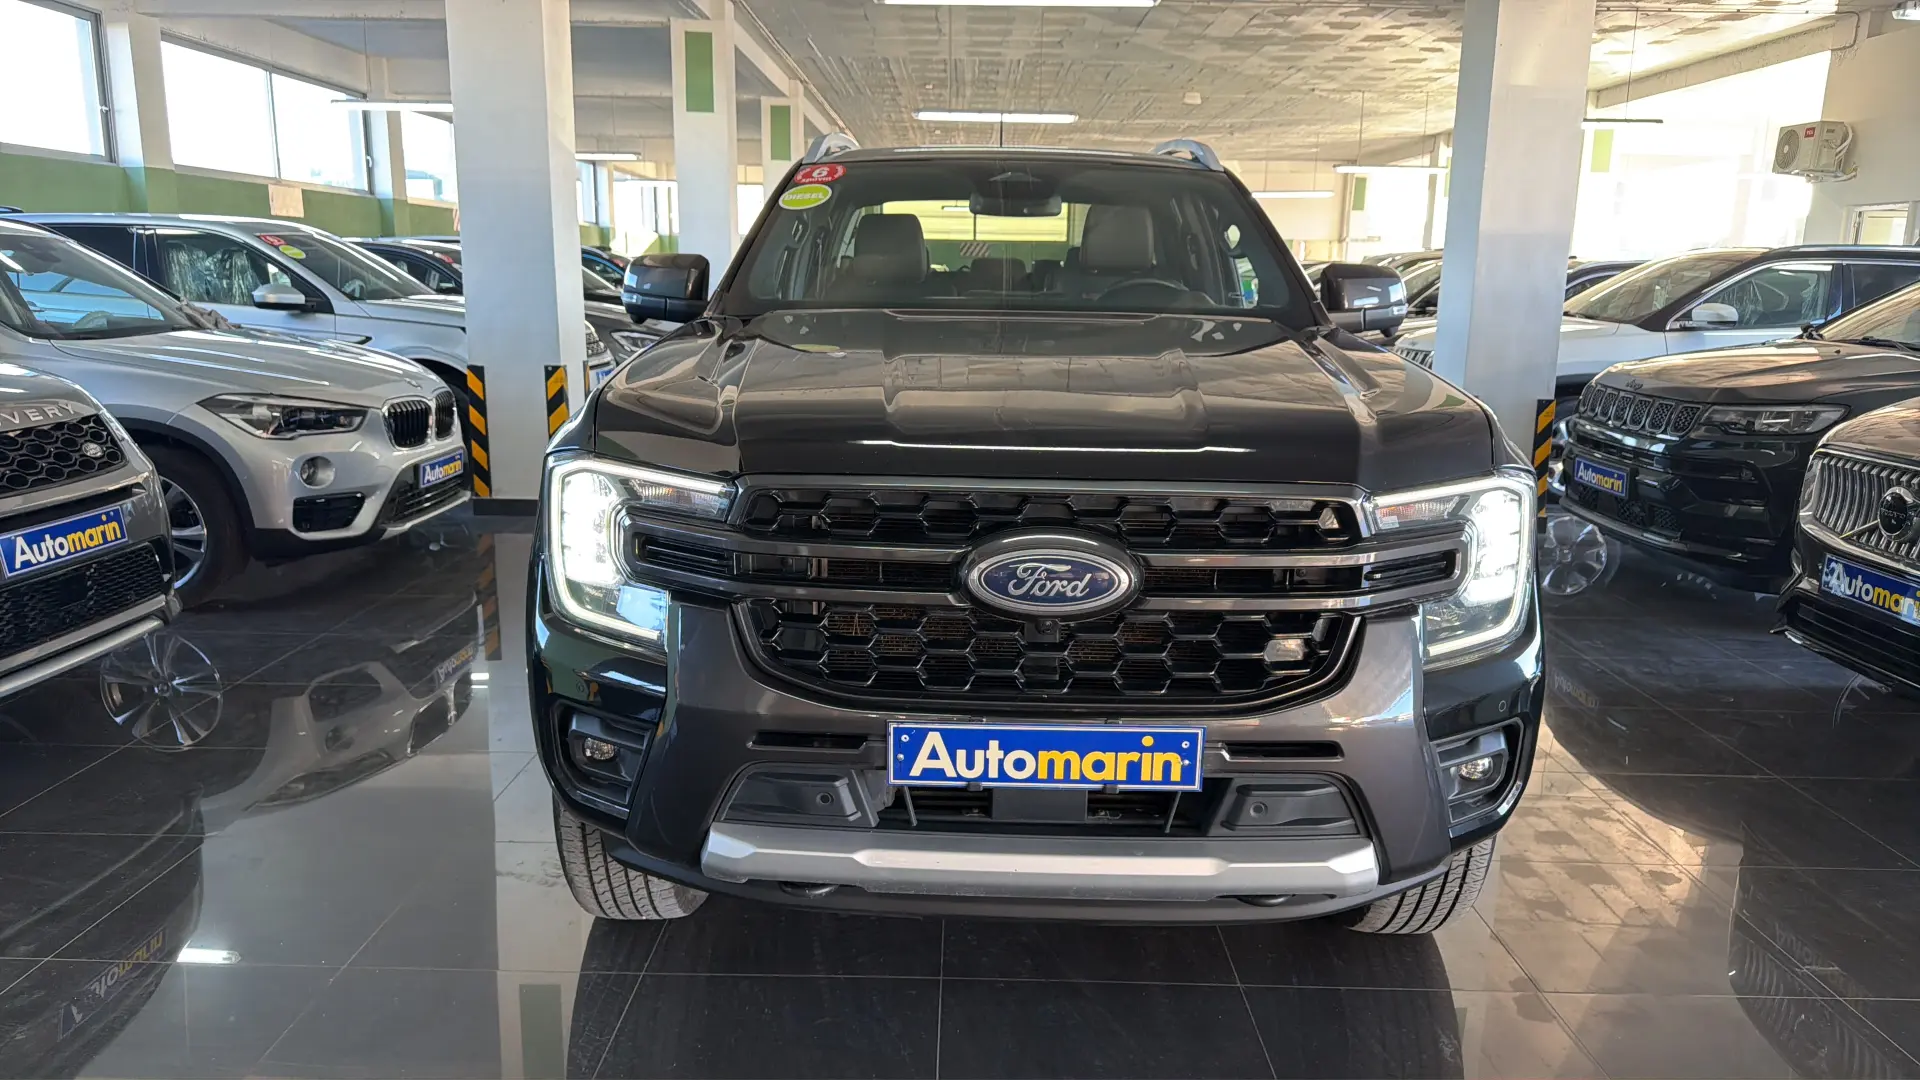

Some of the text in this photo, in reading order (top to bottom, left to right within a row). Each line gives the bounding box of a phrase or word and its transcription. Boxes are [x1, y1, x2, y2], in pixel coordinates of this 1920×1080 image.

[812, 166, 830, 178] 6
[784, 191, 825, 201] DIESEL
[0, 402, 75, 427] VERY
[423, 454, 462, 484] Automarin
[1577, 461, 1623, 492] Automarin
[15, 514, 122, 570] Automarin
[1008, 562, 1093, 598] Ford
[909, 731, 1183, 782] Automarin
